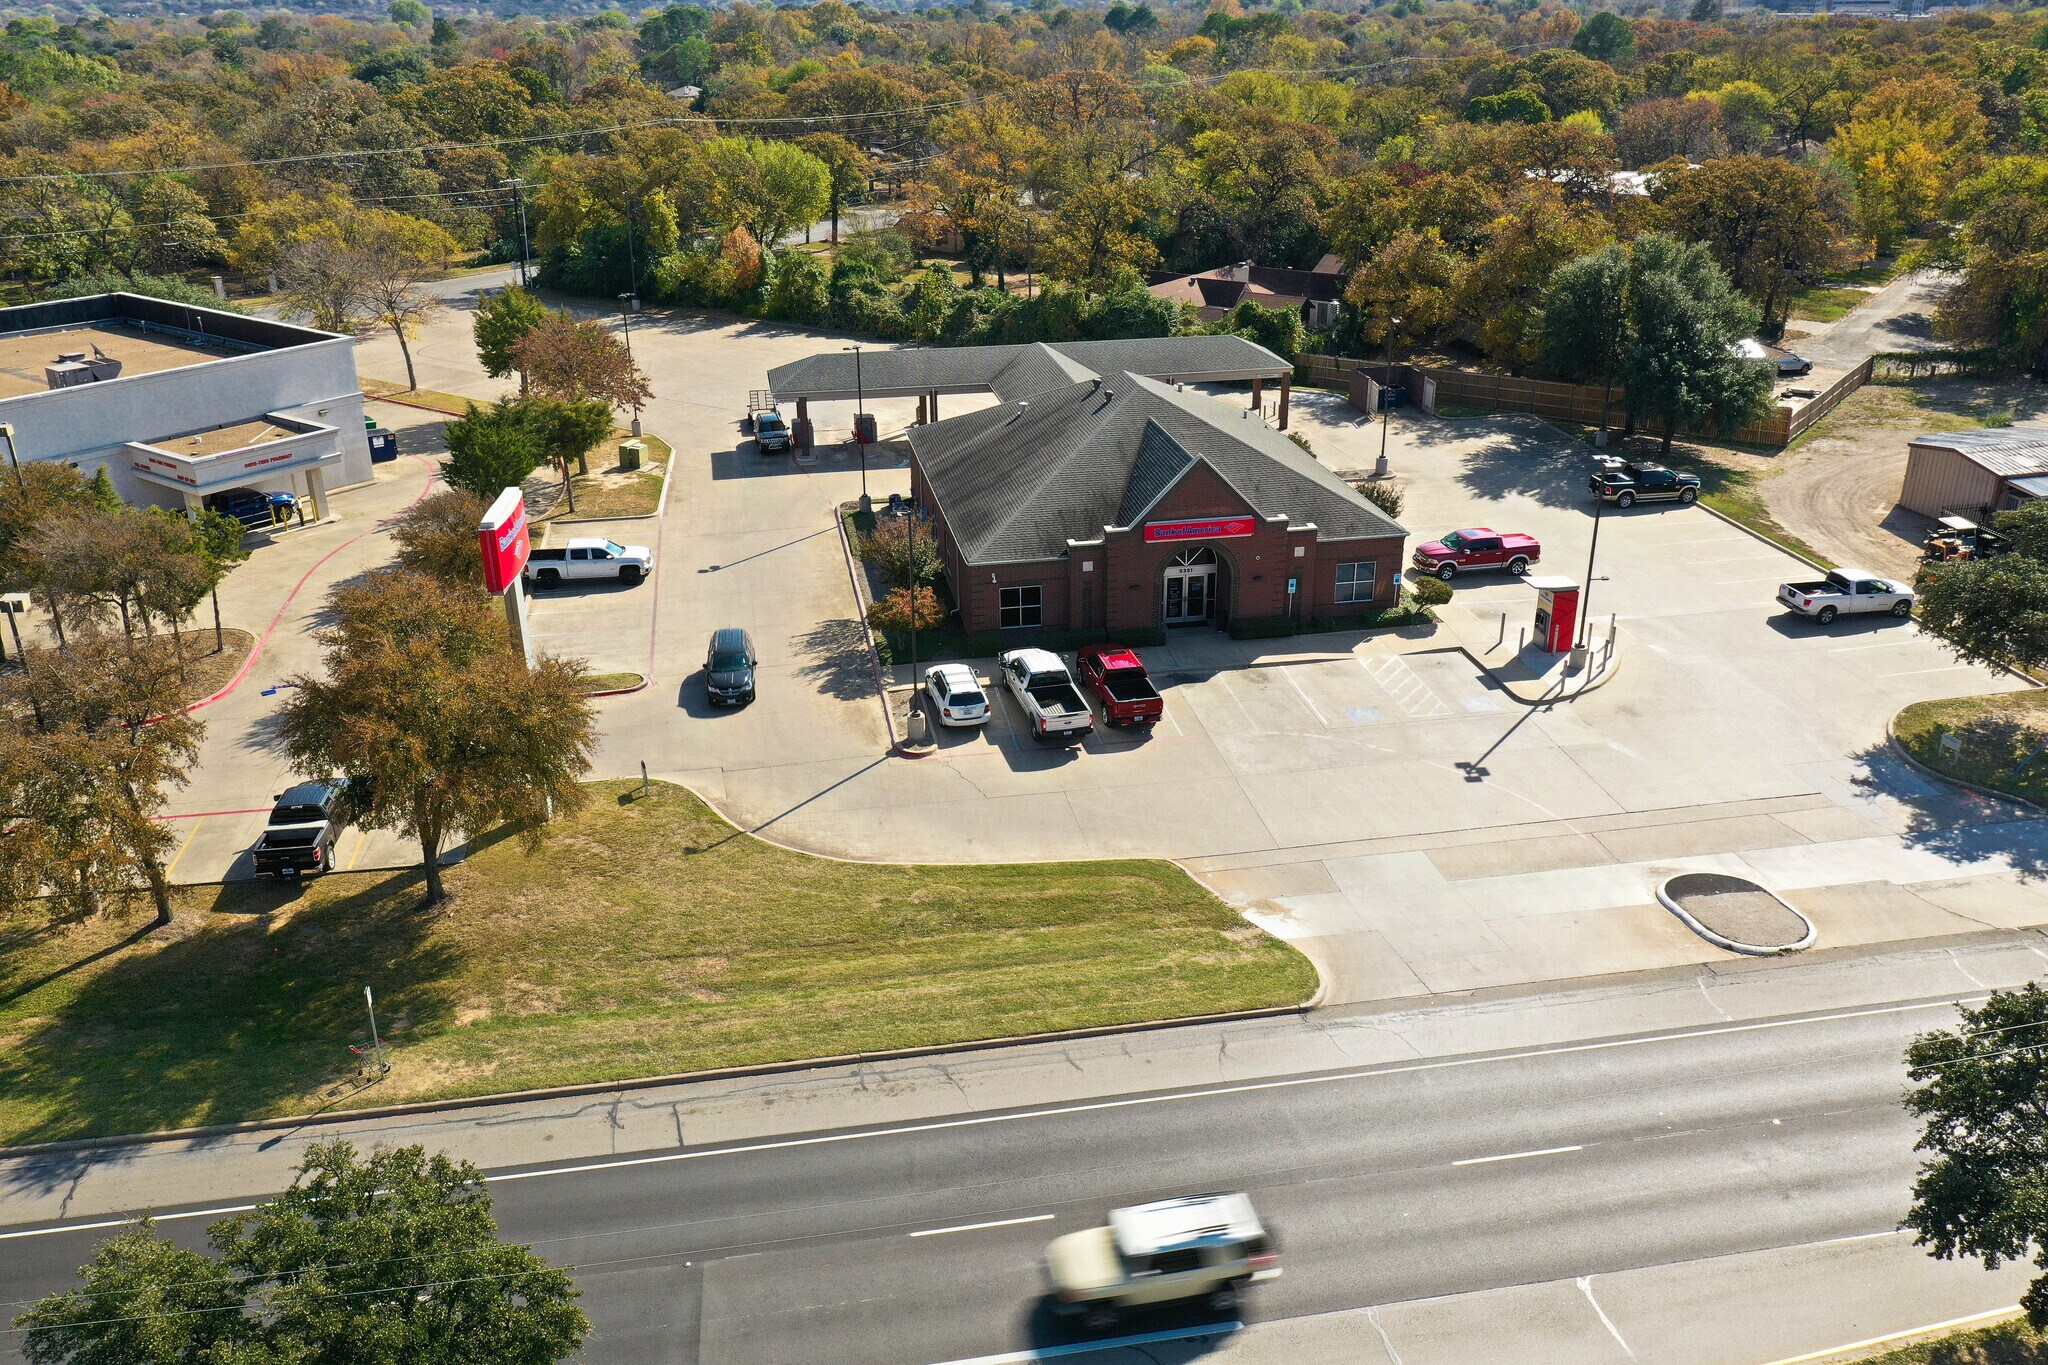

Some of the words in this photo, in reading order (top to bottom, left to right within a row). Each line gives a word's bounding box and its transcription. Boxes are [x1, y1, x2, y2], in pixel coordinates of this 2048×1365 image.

[270, 453, 292, 462] PHARMACY
[1155, 527, 1177, 537] Bank
[1178, 526, 1186, 535] of
[1187, 525, 1222, 535] America
